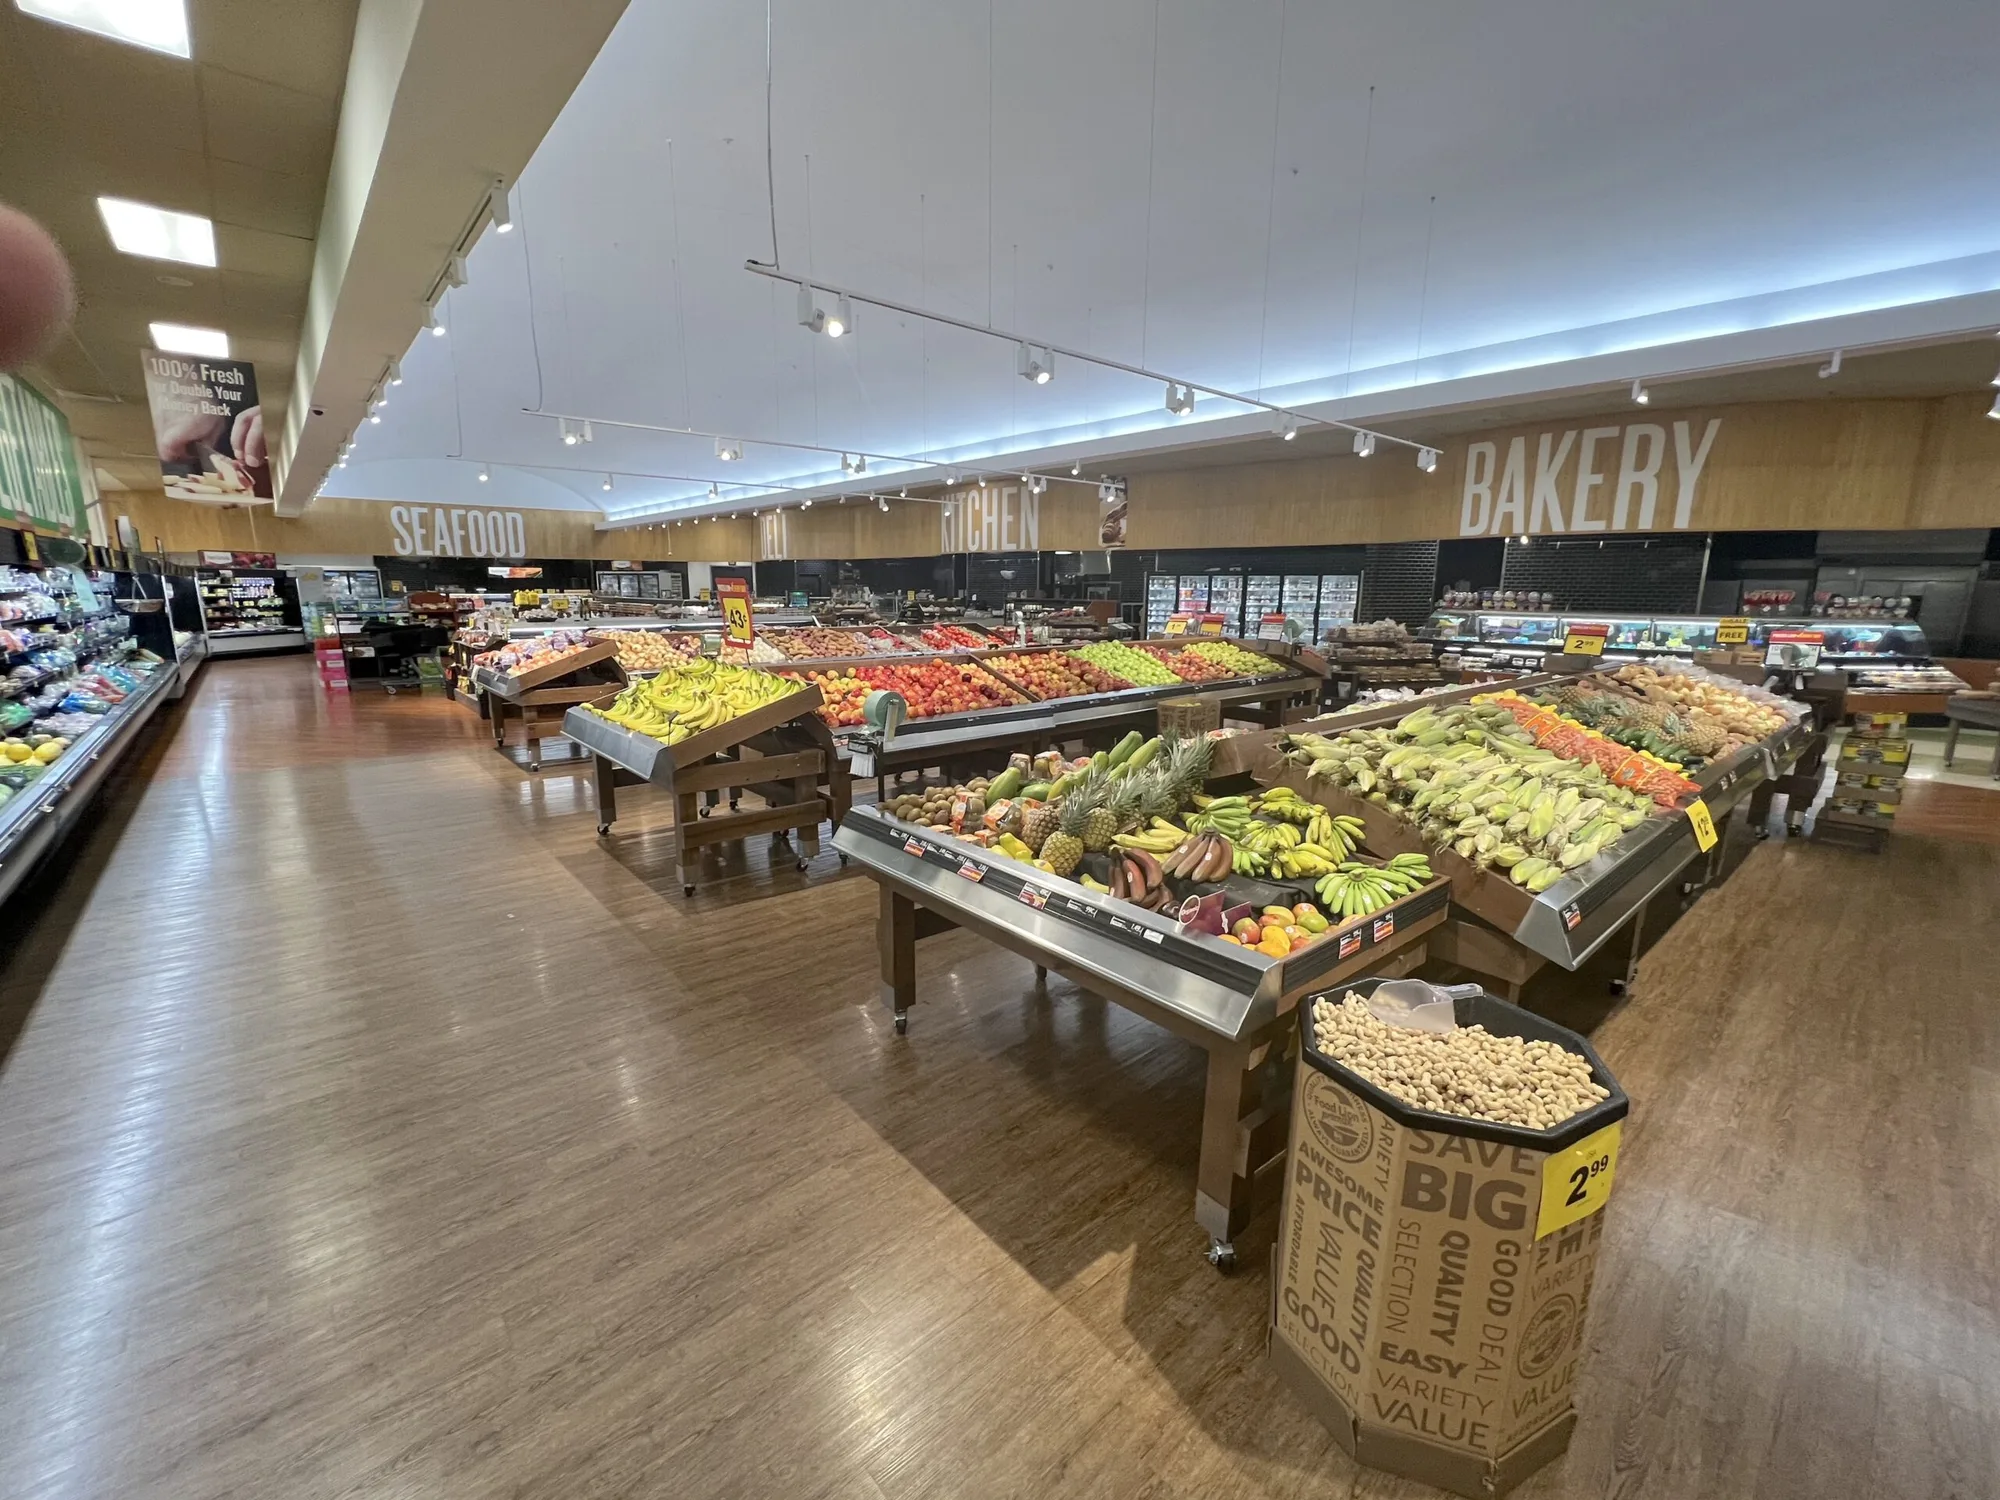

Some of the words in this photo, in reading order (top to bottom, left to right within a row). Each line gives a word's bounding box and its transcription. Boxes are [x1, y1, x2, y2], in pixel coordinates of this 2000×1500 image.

[151, 358, 198, 380] 100%
[200, 363, 244, 386] Fresh
[170, 381, 213, 399] Double
[215, 386, 242, 402] Your
[158, 395, 198, 415] Money
[201, 401, 232, 417] Back
[1459, 418, 1722, 537] BAKERY
[390, 505, 526, 558] SEAFOOD
[760, 514, 787, 560] DELI
[941, 486, 1039, 553] KITCHEN
[1719, 631, 1744, 639] FREE
[1314, 1094, 1336, 1114] Food
[1338, 1104, 1360, 1123] Lion
[1299, 1141, 1384, 1216] AWESOME
[1374, 1117, 1396, 1192] ARIETY
[1409, 1130, 1536, 1176] SAVE
[1296, 1160, 1382, 1252] PRICE
[1401, 1160, 1527, 1231] BIG
[1288, 1192, 1305, 1284] AFFORDABLE
[1312, 1221, 1344, 1320] VALUE
[1350, 1249, 1375, 1351] QUALITY
[1385, 1217, 1421, 1334] SELECTION
[1430, 1230, 1470, 1347] QUALITY
[1486, 1239, 1521, 1317] GOOD
[1280, 1313, 1359, 1405] SELECTION
[1284, 1286, 1360, 1374] GOOD
[1379, 1342, 1468, 1379] EASY
[1474, 1324, 1507, 1384] DEAL
[1371, 1393, 1489, 1450] VALUE
[1376, 1368, 1493, 1416] VARIETY
[1512, 1358, 1578, 1418] VALUE
